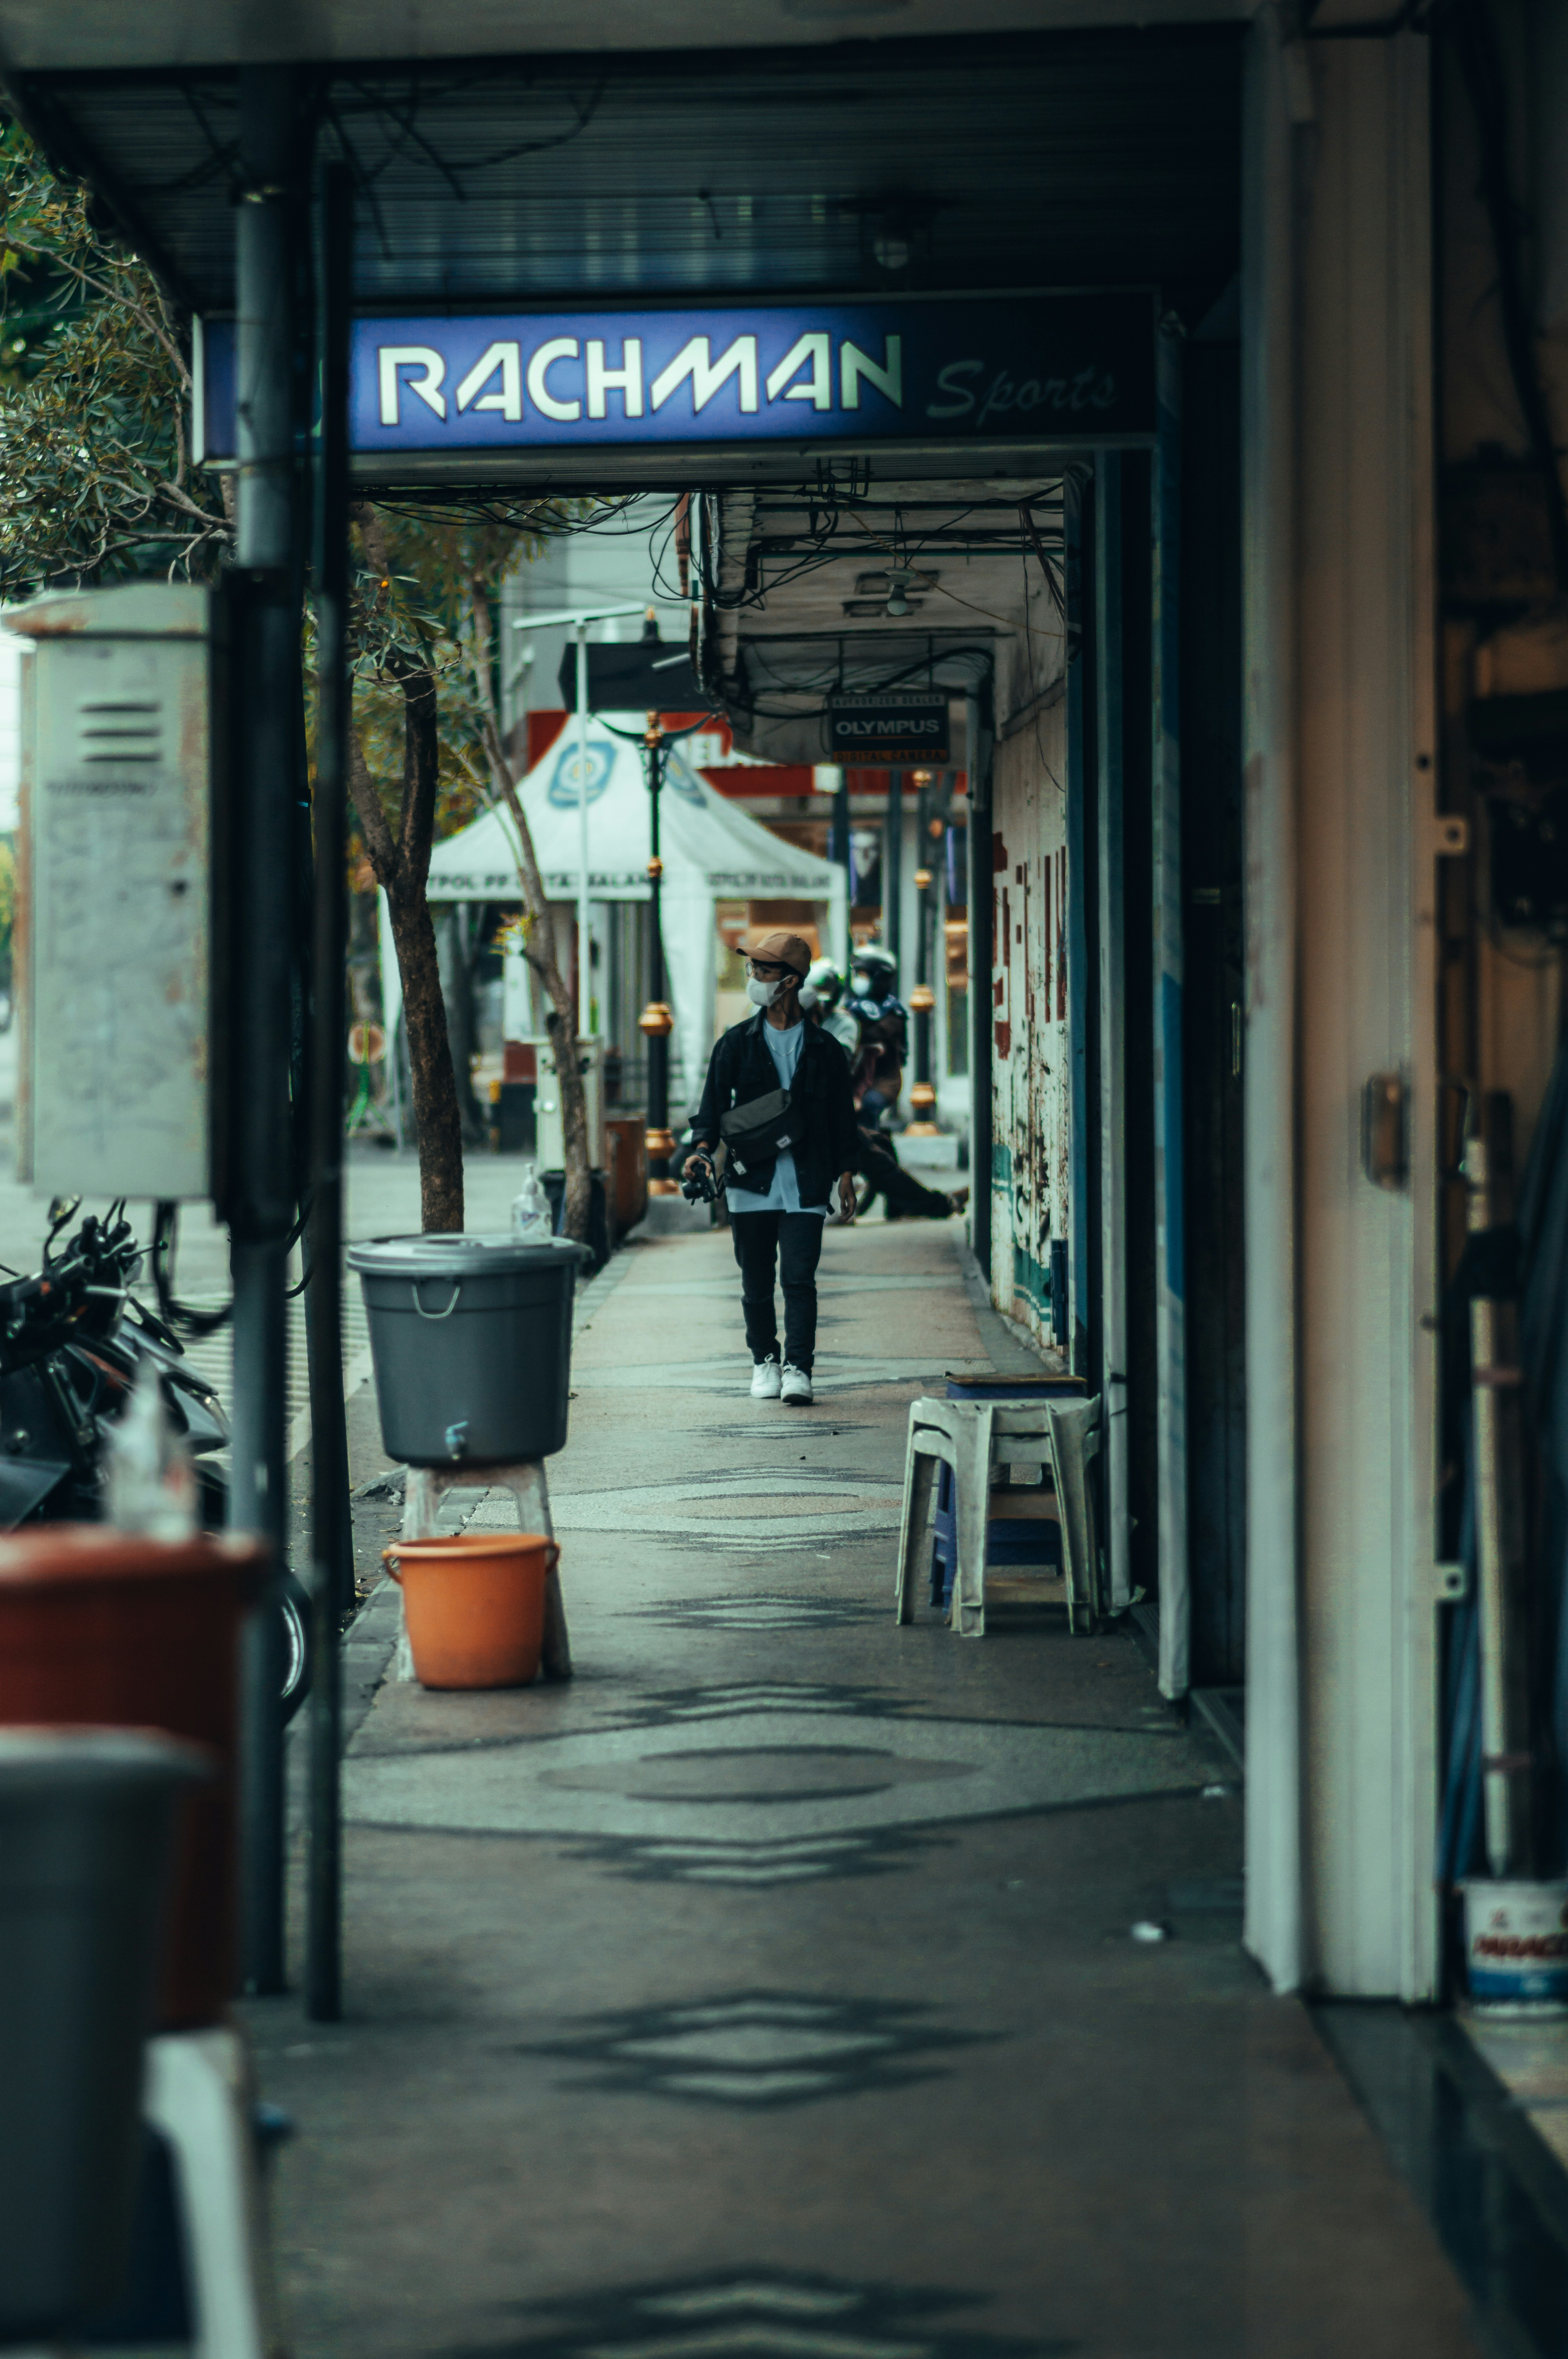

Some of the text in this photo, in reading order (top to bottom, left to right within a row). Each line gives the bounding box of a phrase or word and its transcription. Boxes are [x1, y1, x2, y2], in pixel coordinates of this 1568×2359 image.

[378, 333, 1116, 429] RACHMAN Sports
[835, 696, 940, 705] AUTHORIZED DEALER
[836, 719, 940, 735] OLYMPUS
[837, 751, 940, 761] DIGITAL CAMERA
